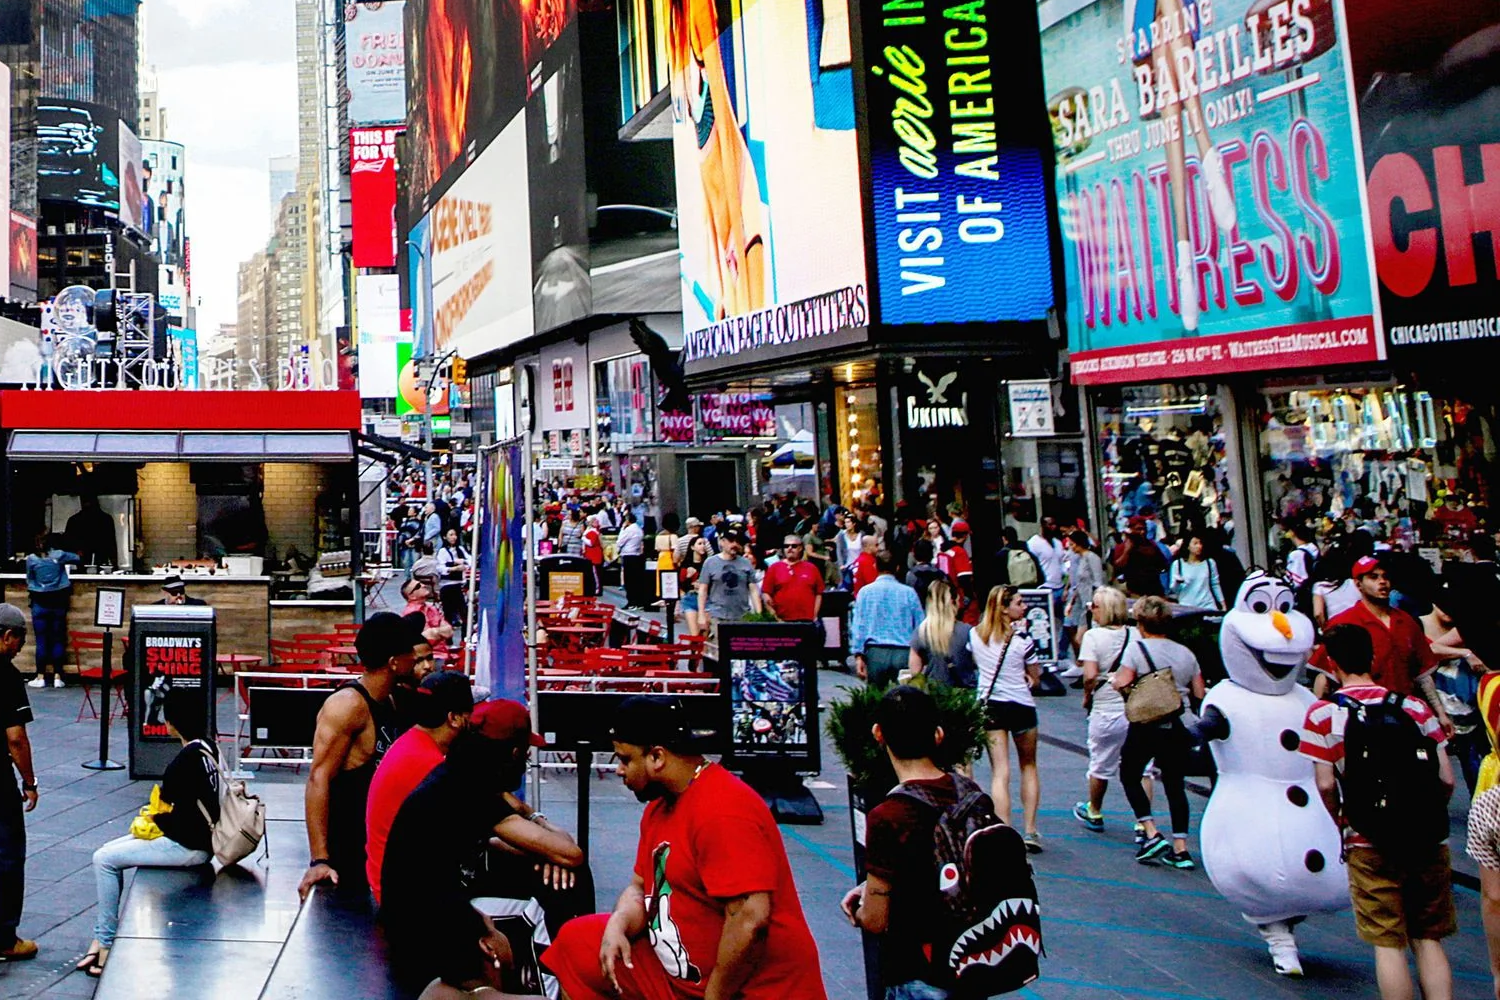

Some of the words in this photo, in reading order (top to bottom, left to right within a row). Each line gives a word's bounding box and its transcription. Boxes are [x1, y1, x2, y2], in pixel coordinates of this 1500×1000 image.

[871, 45, 939, 179] aerie
[1058, 77, 1131, 148] SARA
[1106, 130, 1141, 163] THRU
[1145, 115, 1181, 151] JUNE
[1204, 87, 1255, 129] ONLY!
[352, 131, 383, 145] THIS
[353, 145, 380, 160] FOR
[894, 187, 947, 296] VISIT
[956, 194, 1005, 244] OF
[1066, 118, 1343, 331] WAITRESS
[104, 234, 114, 273] 1500
[684, 316, 735, 362] AMERICAN
[736, 307, 775, 351] EAGLE
[775, 283, 867, 343] OUTFITTERS
[145, 637, 202, 648] BROADWAY'S
[146, 648, 202, 662] SURE
[146, 662, 202, 675] THING
